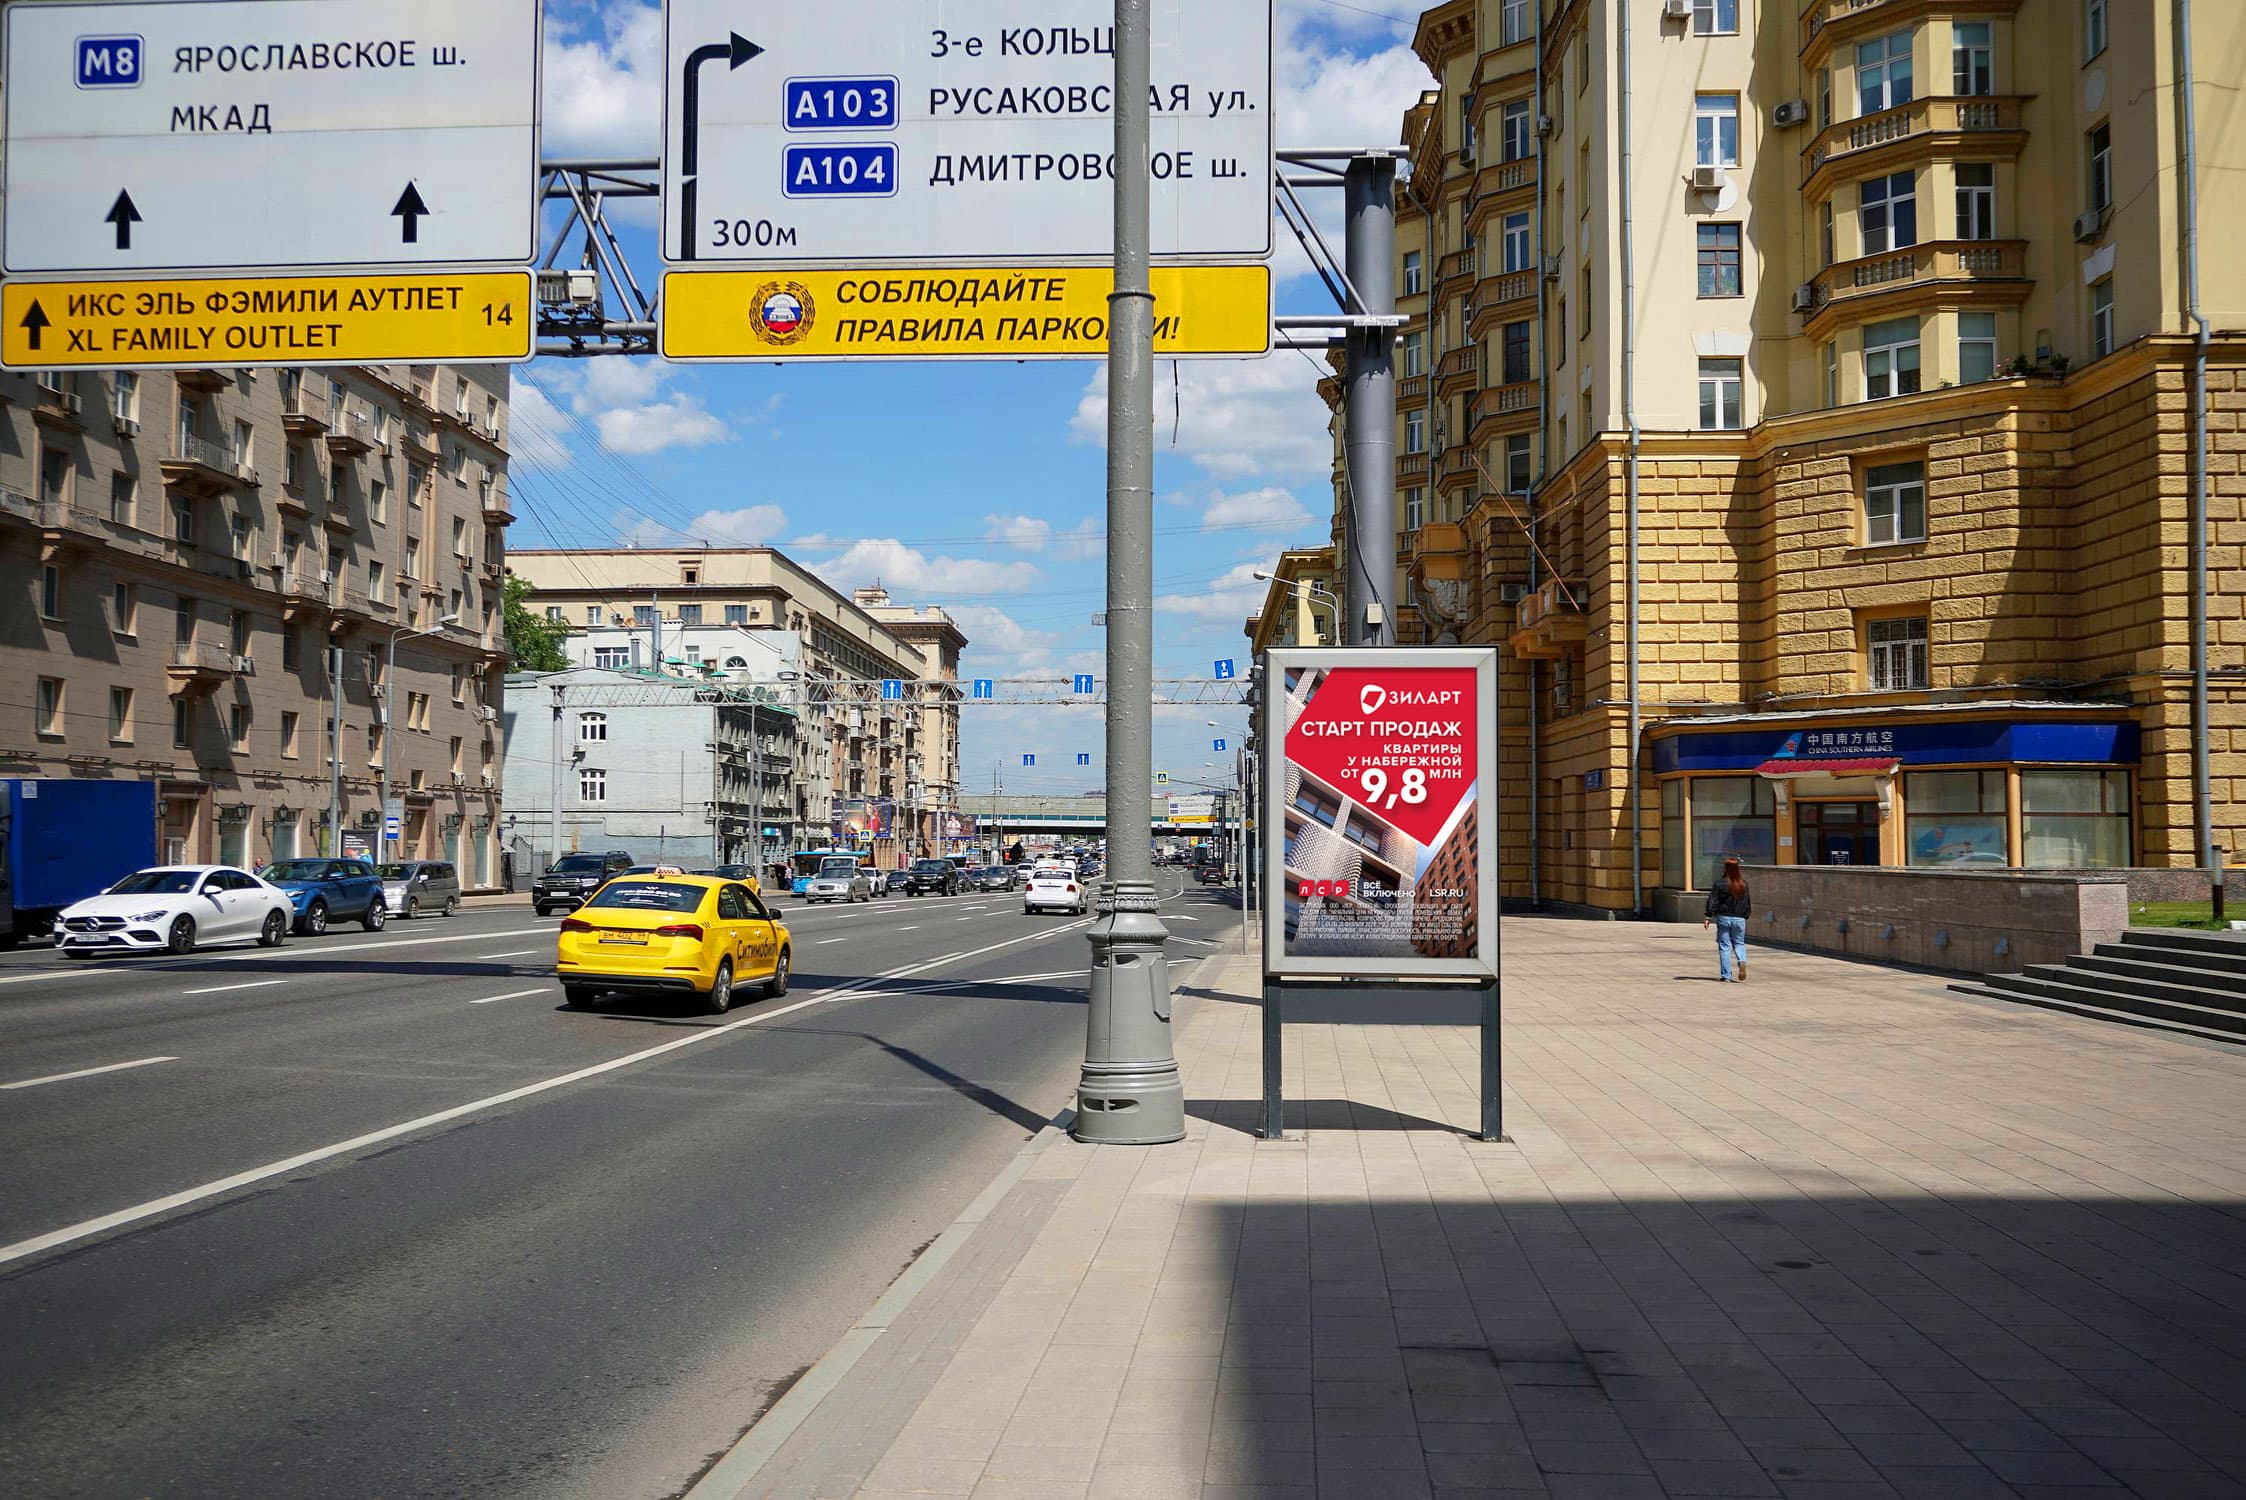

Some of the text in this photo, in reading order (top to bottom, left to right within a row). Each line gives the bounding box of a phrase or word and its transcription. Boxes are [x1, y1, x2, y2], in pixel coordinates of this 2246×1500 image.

[173, 40, 466, 73] ЯРОСЛАВСКОЕ ш.
[930, 26, 1116, 59] 3-е КОЛЬЦ
[82, 45, 136, 77] М8
[794, 88, 889, 119] А103
[930, 84, 1256, 119] РУСАКОВСАЯ ул.
[170, 103, 272, 135] МКАД
[795, 155, 886, 185] А104
[929, 152, 1248, 185] ДМИТРОВОЕ ш.
[712, 219, 798, 247] 300м
[68, 286, 464, 317] ИКС ЭЛЬ ФЭМИЛИ АУТЛЕТ
[835, 274, 1067, 308] СОБЛЮДАЙТЕ
[481, 303, 513, 326] 14
[66, 324, 343, 352] XL FAMILY OUTLET
[835, 316, 1181, 343] ПРАВИЛА ПАРКОИ!
[1388, 690, 1462, 705] ЗИЛАРТ
[1301, 721, 1462, 739] СТАРТ ПРОДАЖ
[1807, 731, 1894, 746] 中国南方航空
[1347, 754, 1462, 766] У НАБЕРЕЖНОЙ
[1383, 743, 1462, 754] КВАРТИРЫ
[1829, 746, 1863, 754] SOUTHERN
[1340, 768, 1360, 779] ОТ
[1360, 768, 1428, 810] 9,8
[1363, 881, 1381, 890] ВСЁ
[1363, 889, 1416, 898] ВКЛЮЧЕНО
[1429, 888, 1464, 898] LSR.RU
